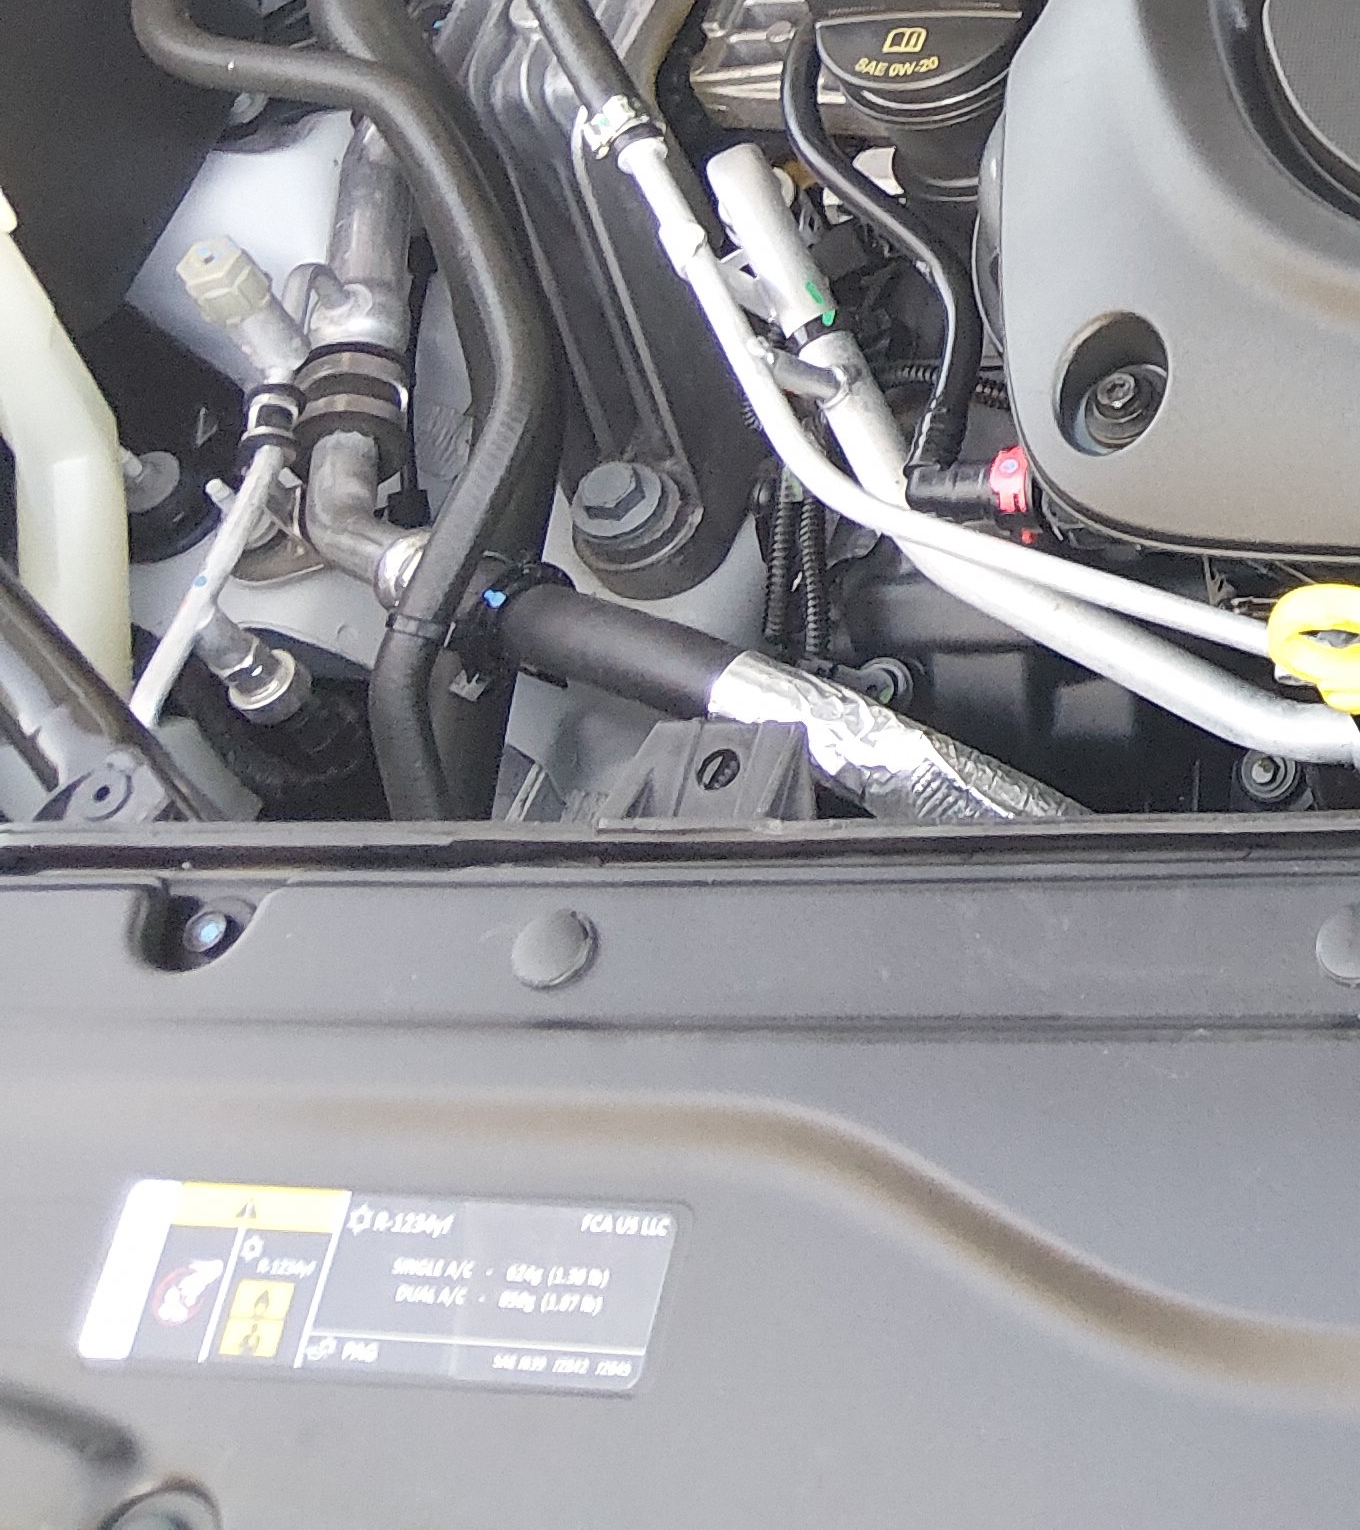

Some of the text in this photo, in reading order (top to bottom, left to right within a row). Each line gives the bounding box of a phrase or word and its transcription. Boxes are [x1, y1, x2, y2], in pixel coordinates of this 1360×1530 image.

[855, 56, 939, 77] SAE 0W-20
[581, 1213, 613, 1233] FCA
